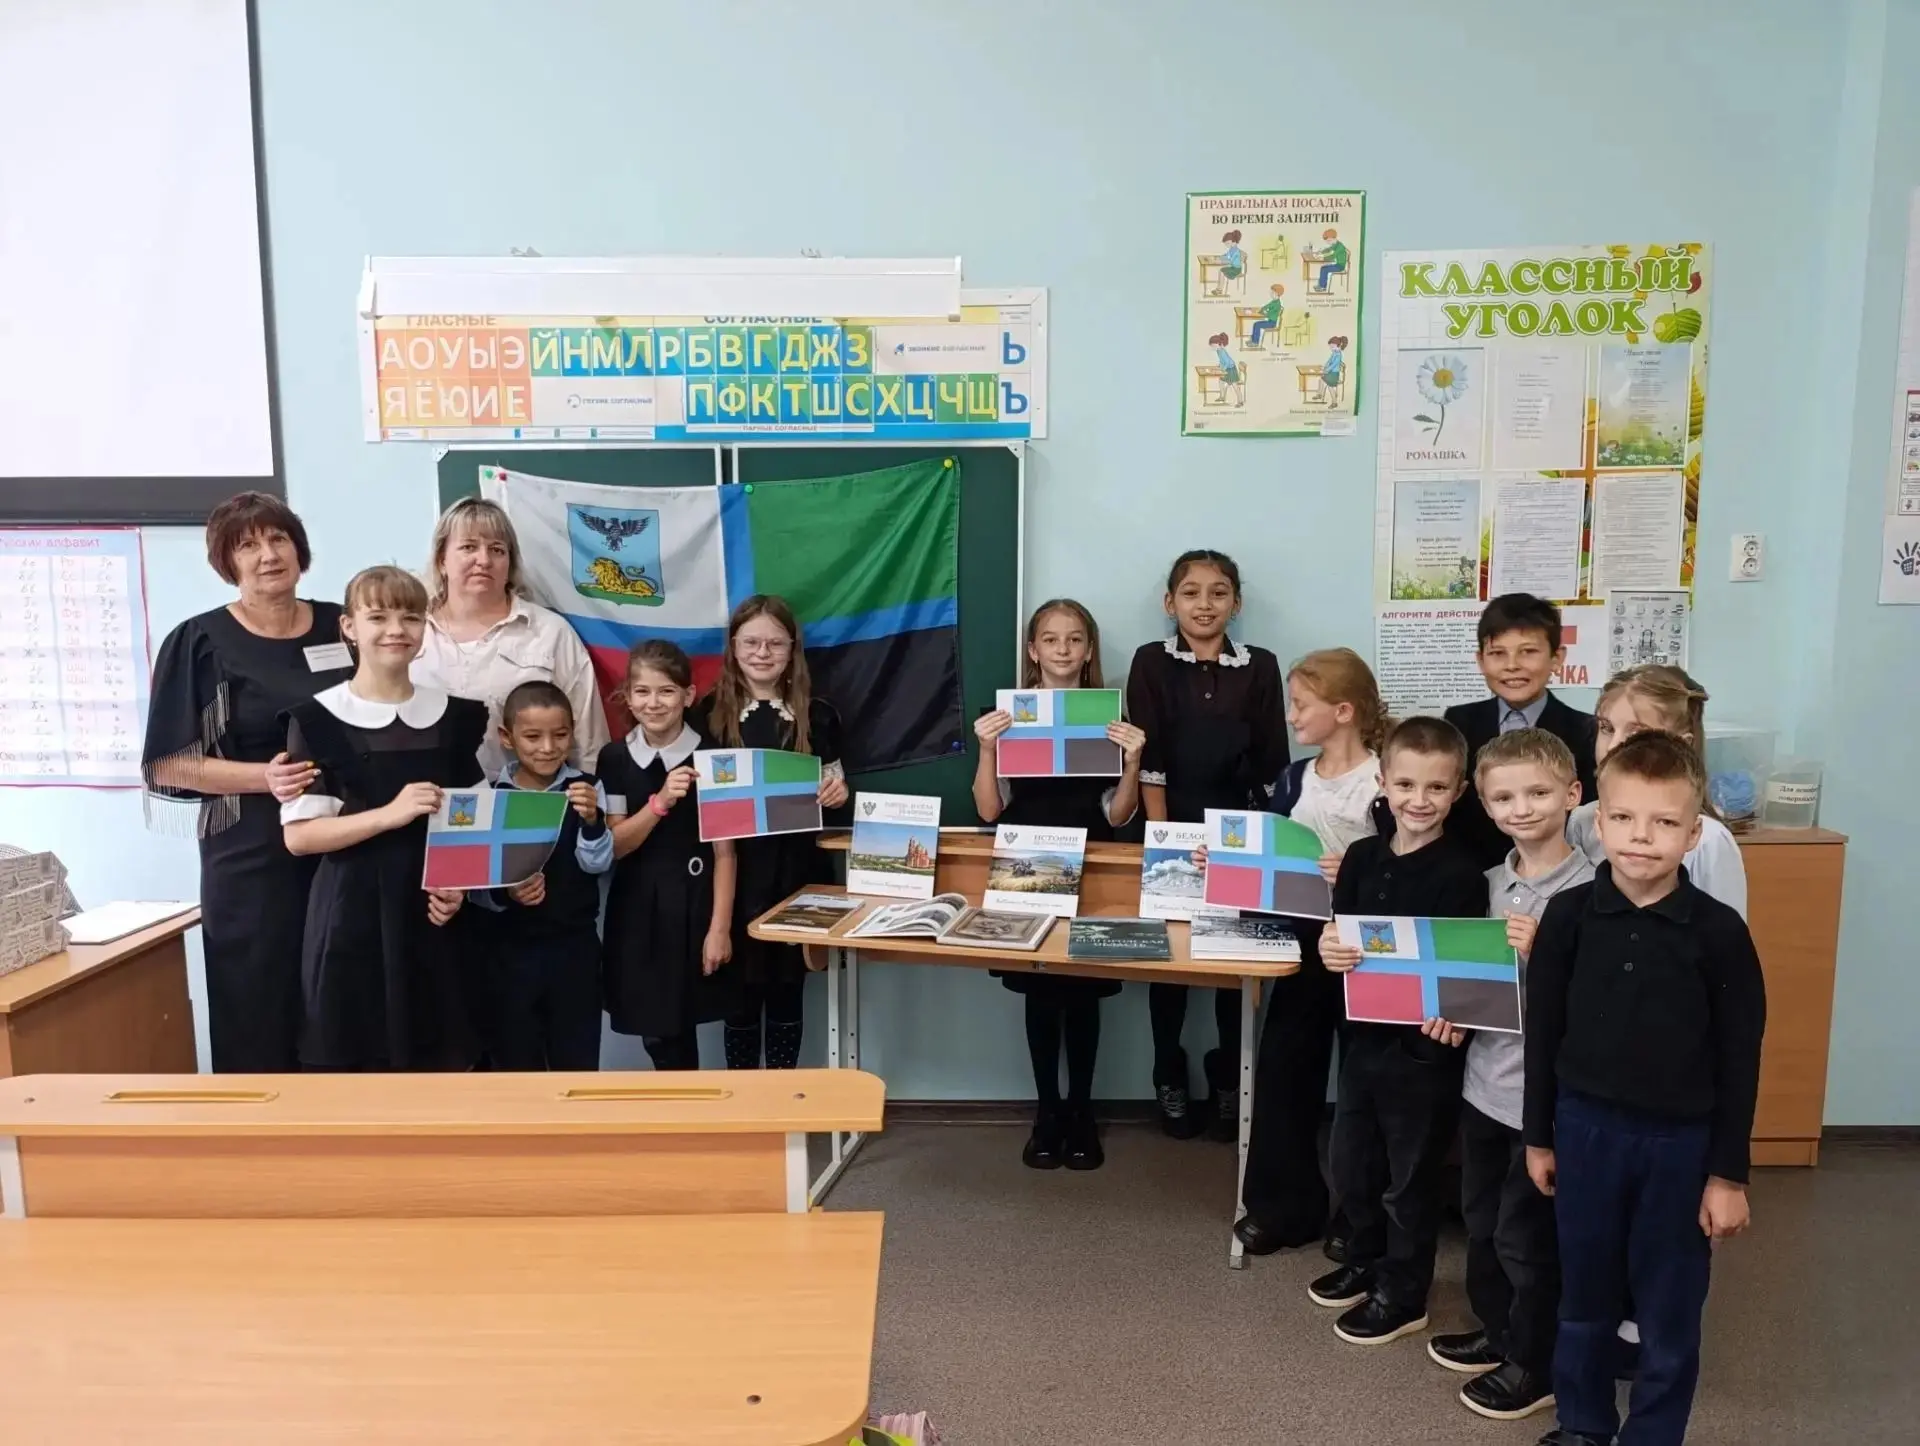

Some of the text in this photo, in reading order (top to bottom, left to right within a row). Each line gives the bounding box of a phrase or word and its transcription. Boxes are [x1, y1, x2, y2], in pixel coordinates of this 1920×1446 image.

[1199, 197, 1352, 210] ПРАВИЛЬНАЯ ПОСАДКА
[1211, 211, 1340, 225] ВО ВРЕМЯ ЗАНЯТИЙ
[1400, 248, 1695, 297] КЛАССНЫЙ
[1443, 299, 1649, 339] УГОЛОК
[1405, 450, 1467, 461] РОМАШКА
[1381, 611, 1432, 620] АЛГОРИТМ
